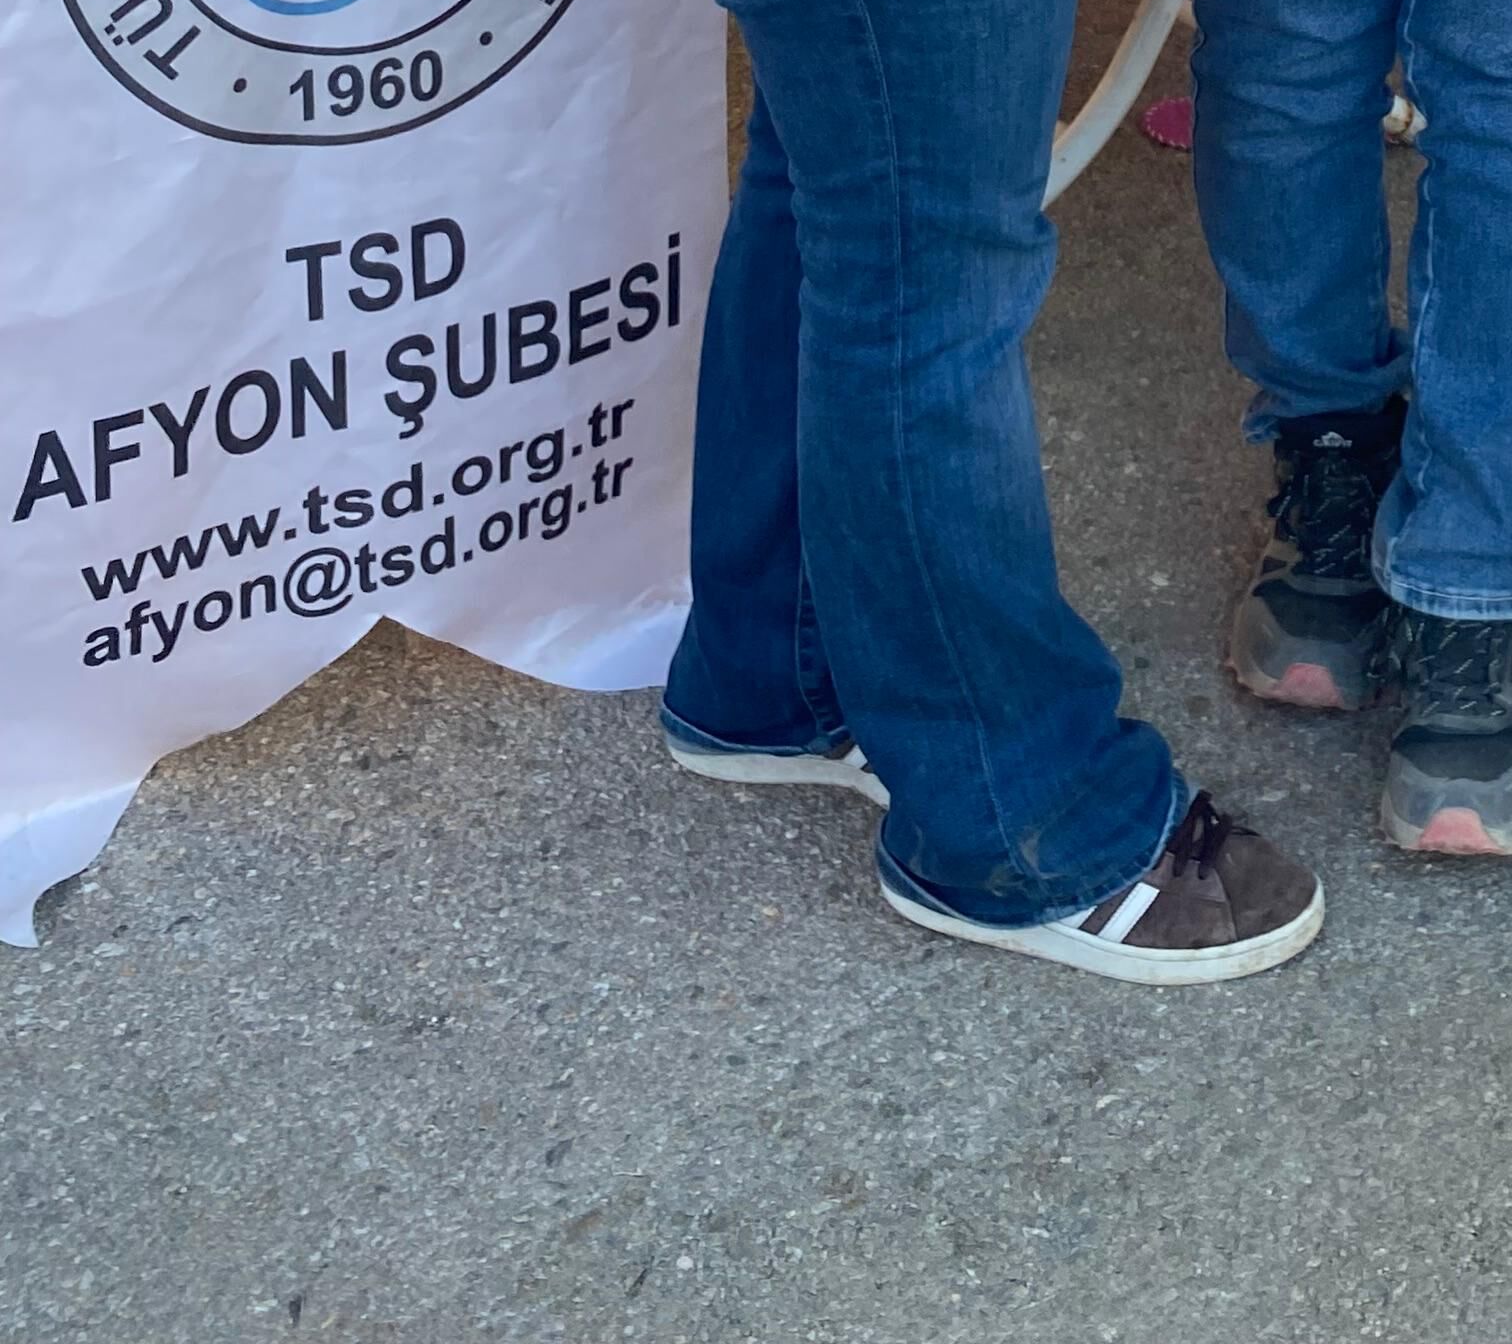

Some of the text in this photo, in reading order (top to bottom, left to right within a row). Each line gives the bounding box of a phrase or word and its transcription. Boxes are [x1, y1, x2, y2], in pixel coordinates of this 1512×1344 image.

[289, 49, 445, 122] 1960
[286, 216, 467, 322] TSD
[13, 233, 682, 522] AFYON ŞUBESİ
[81, 398, 635, 601] www.tsd.org.tr
[83, 457, 633, 667] afyon@tsd.org.tr
